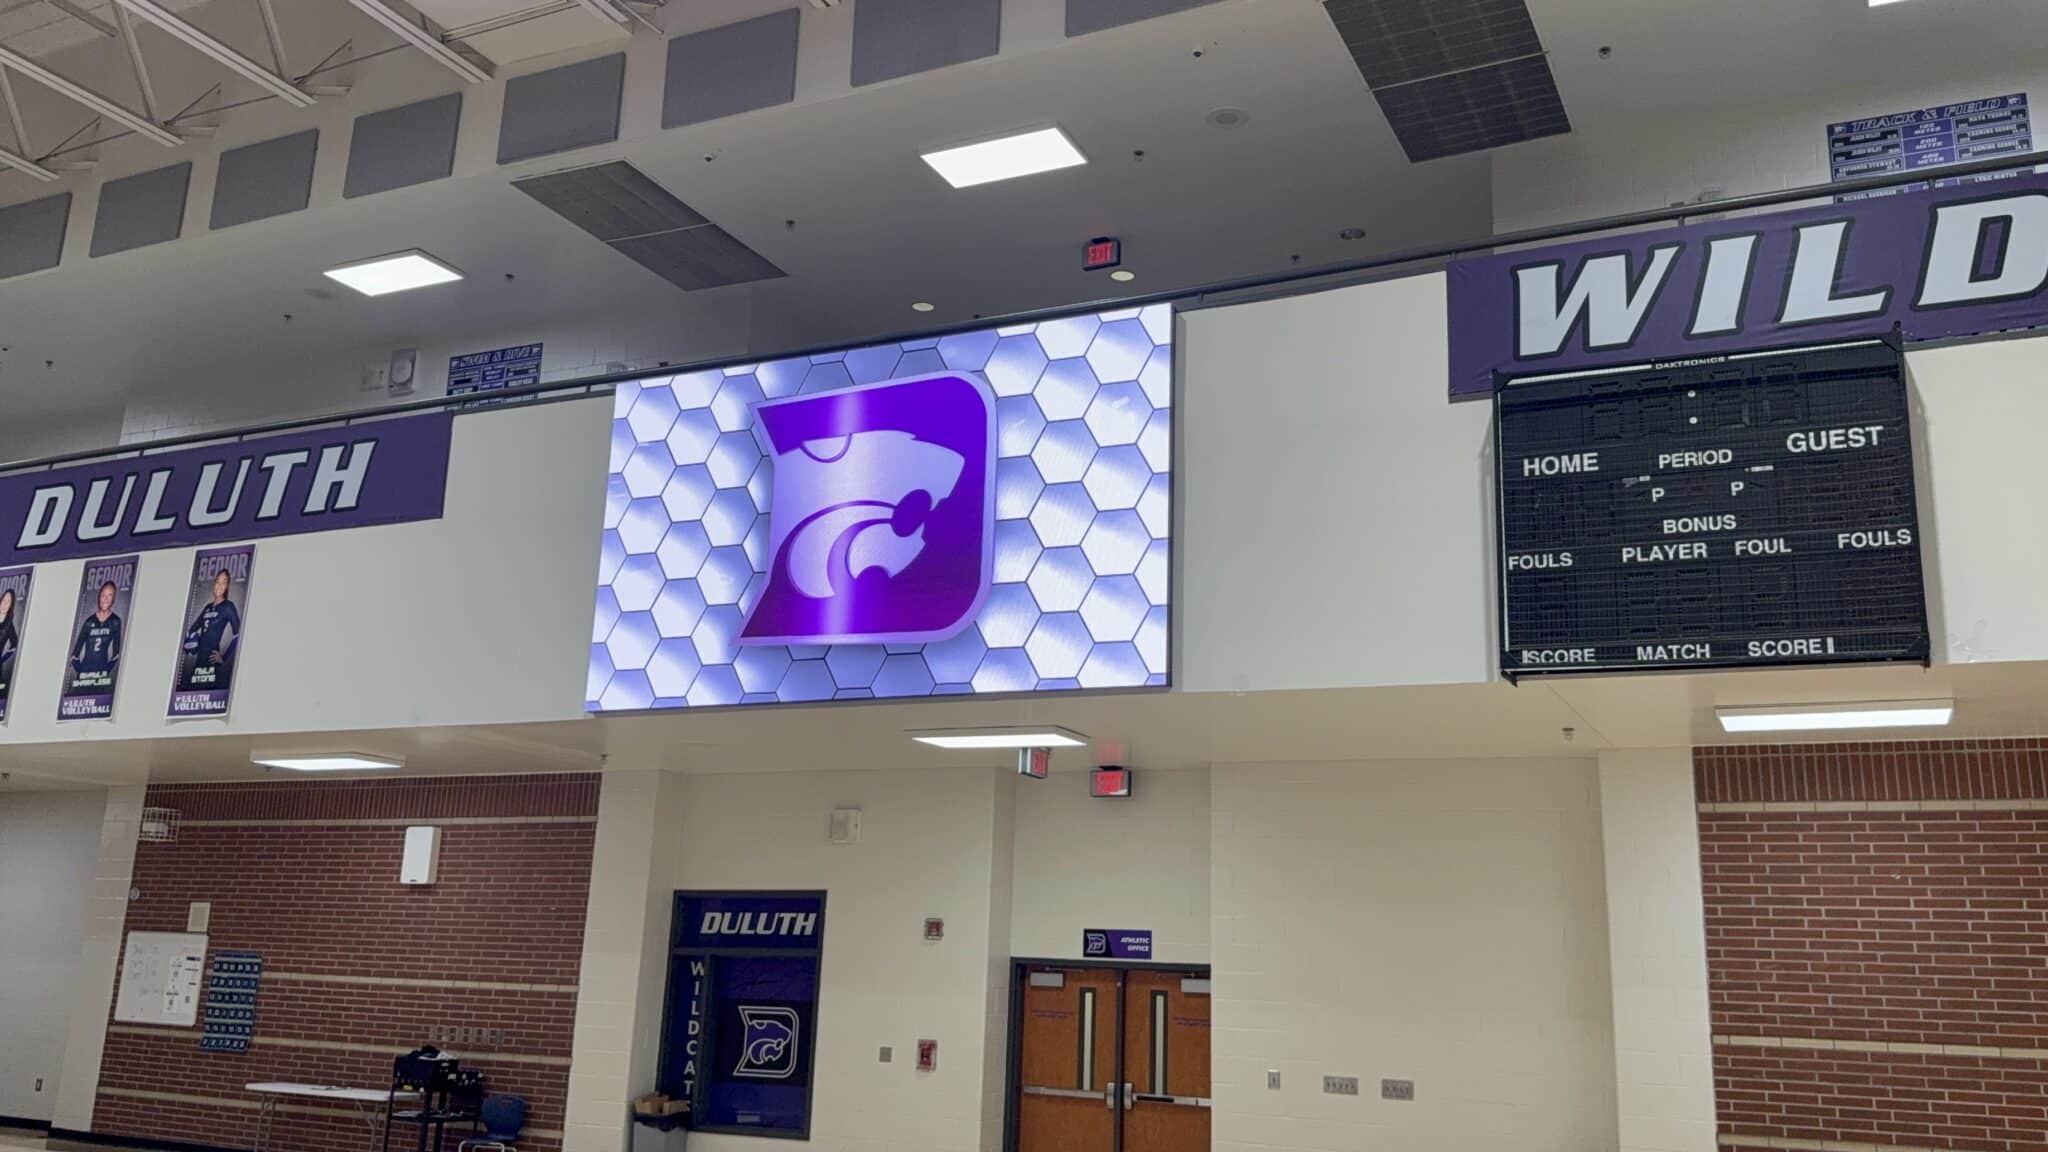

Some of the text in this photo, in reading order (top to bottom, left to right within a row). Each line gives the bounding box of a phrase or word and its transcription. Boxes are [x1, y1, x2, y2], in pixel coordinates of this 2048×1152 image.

[1854, 112, 1916, 131] TRACK
[1921, 109, 1938, 121] &
[1944, 99, 2000, 118] FIELD
[1914, 126, 1941, 135] METER
[1915, 141, 1942, 150] METER
[1917, 156, 1944, 165] METER
[1514, 194, 2048, 359] WILD
[1655, 356, 1726, 370] DAKTRONICS
[1786, 425, 1883, 453] GUEST
[1522, 452, 1599, 477] HOME
[1658, 448, 1733, 469] PERIOD
[15, 439, 380, 549] DULUTH
[1651, 487, 1665, 502] P
[1730, 481, 1744, 496] P
[1663, 514, 1737, 534] BONUS
[1837, 528, 1912, 549] FOULS
[1621, 538, 1792, 563] PLAYER FOUL
[199, 553, 248, 582] SENIOR
[1508, 552, 1573, 570] FOULS
[87, 564, 132, 591] SENIOR
[94, 637, 102, 652] 2
[1637, 644, 1711, 661] MATCH
[62, 705, 110, 715] VOLLEYBALL
[174, 701, 226, 711] VOLLEYBALL
[700, 912, 816, 936] DULUTH
[1120, 936, 1150, 944] ATHLETIC
[1127, 944, 1150, 952] OFFICE
